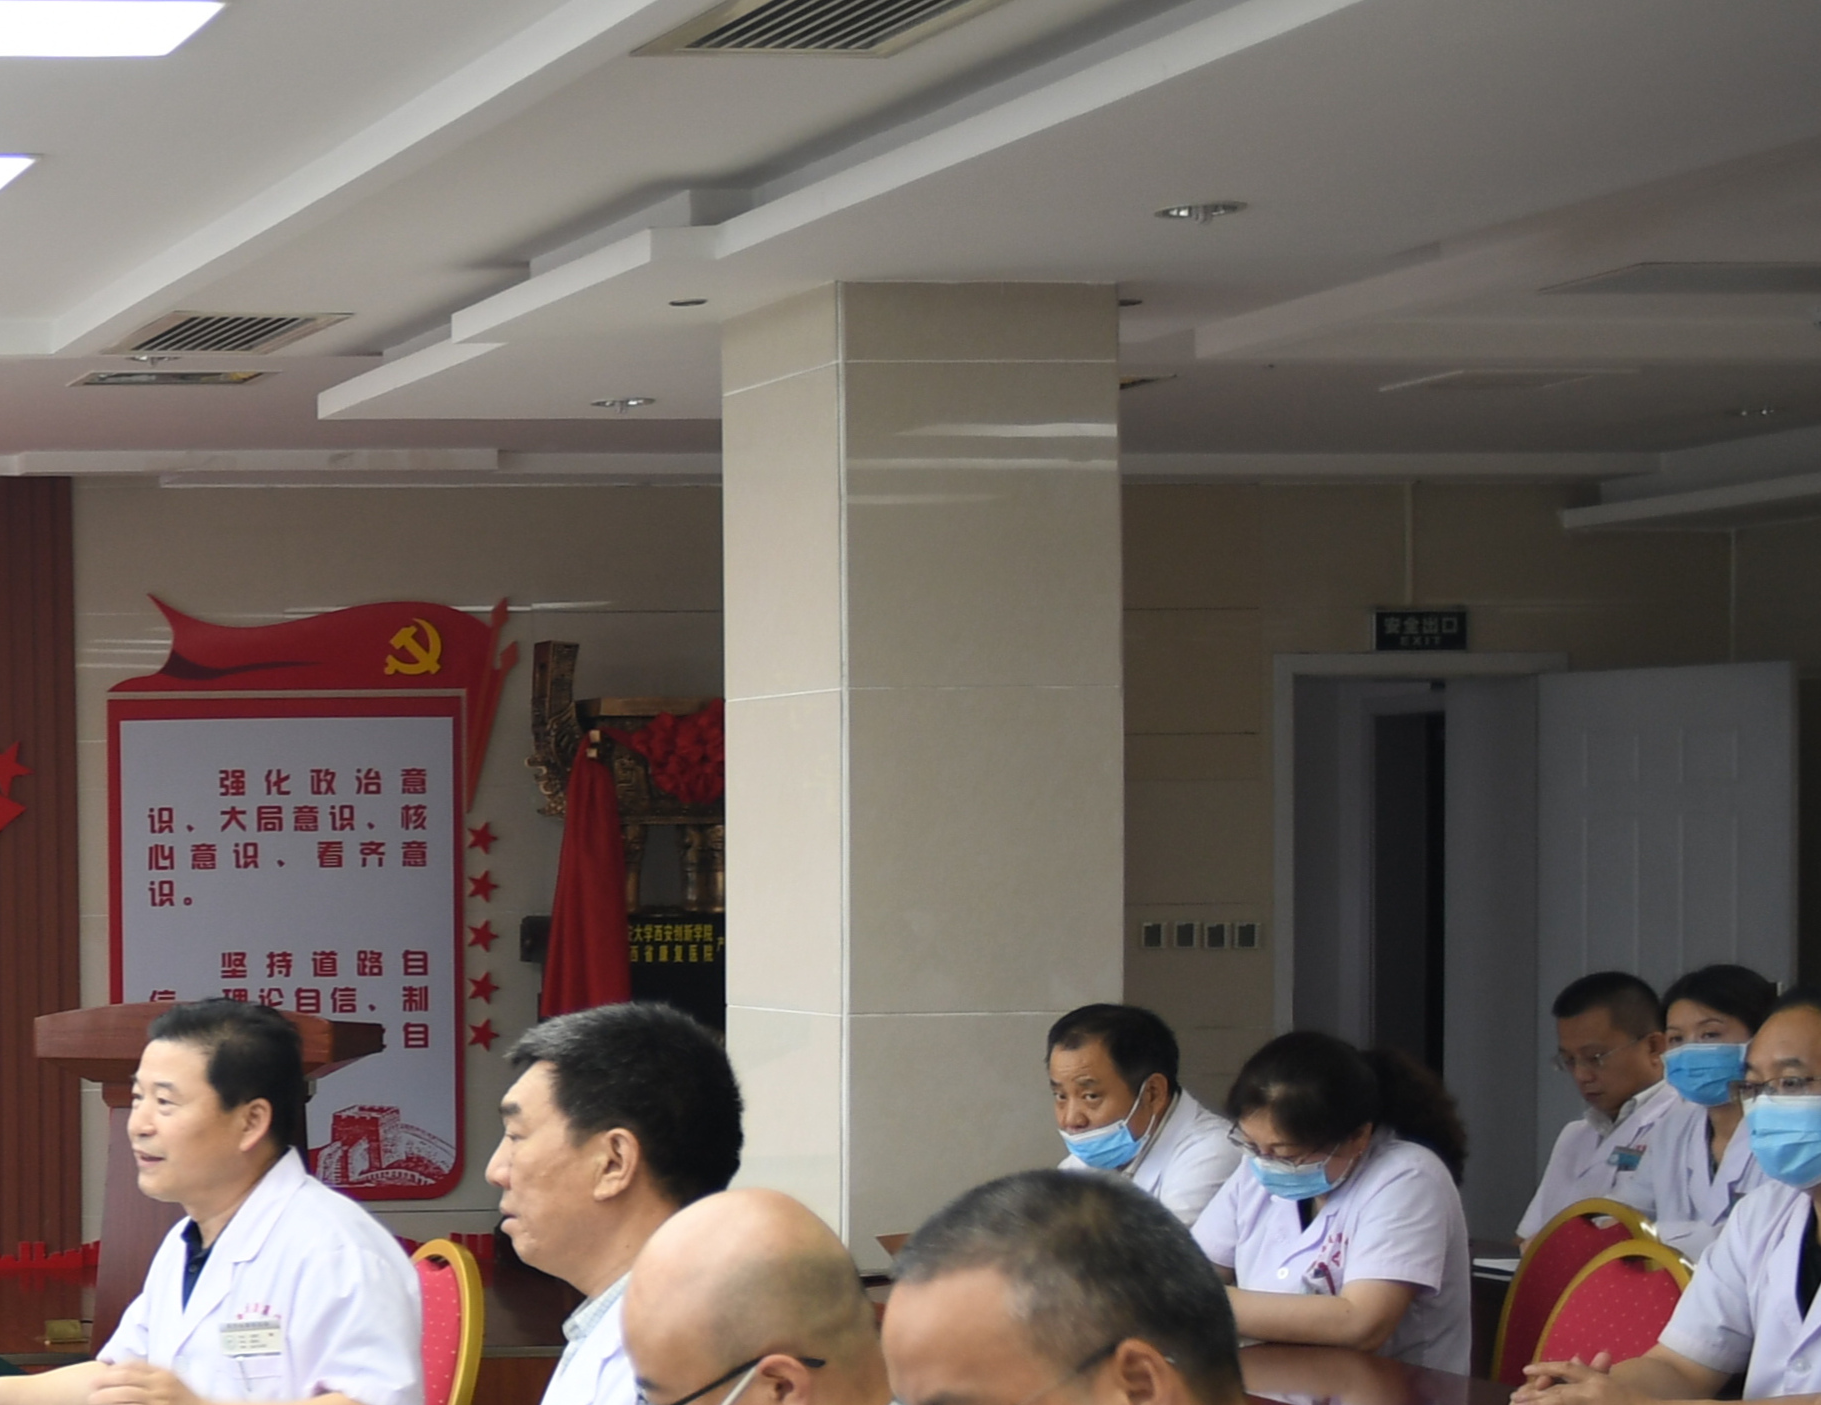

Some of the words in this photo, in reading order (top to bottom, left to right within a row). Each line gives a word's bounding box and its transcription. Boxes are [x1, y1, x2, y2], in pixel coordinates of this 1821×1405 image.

[219, 768, 428, 797] 强化政治意
[148, 804, 428, 834] 识、大局意识、核
[148, 840, 429, 871] 心意识、看齐意
[221, 950, 430, 979] 坚持道路自
